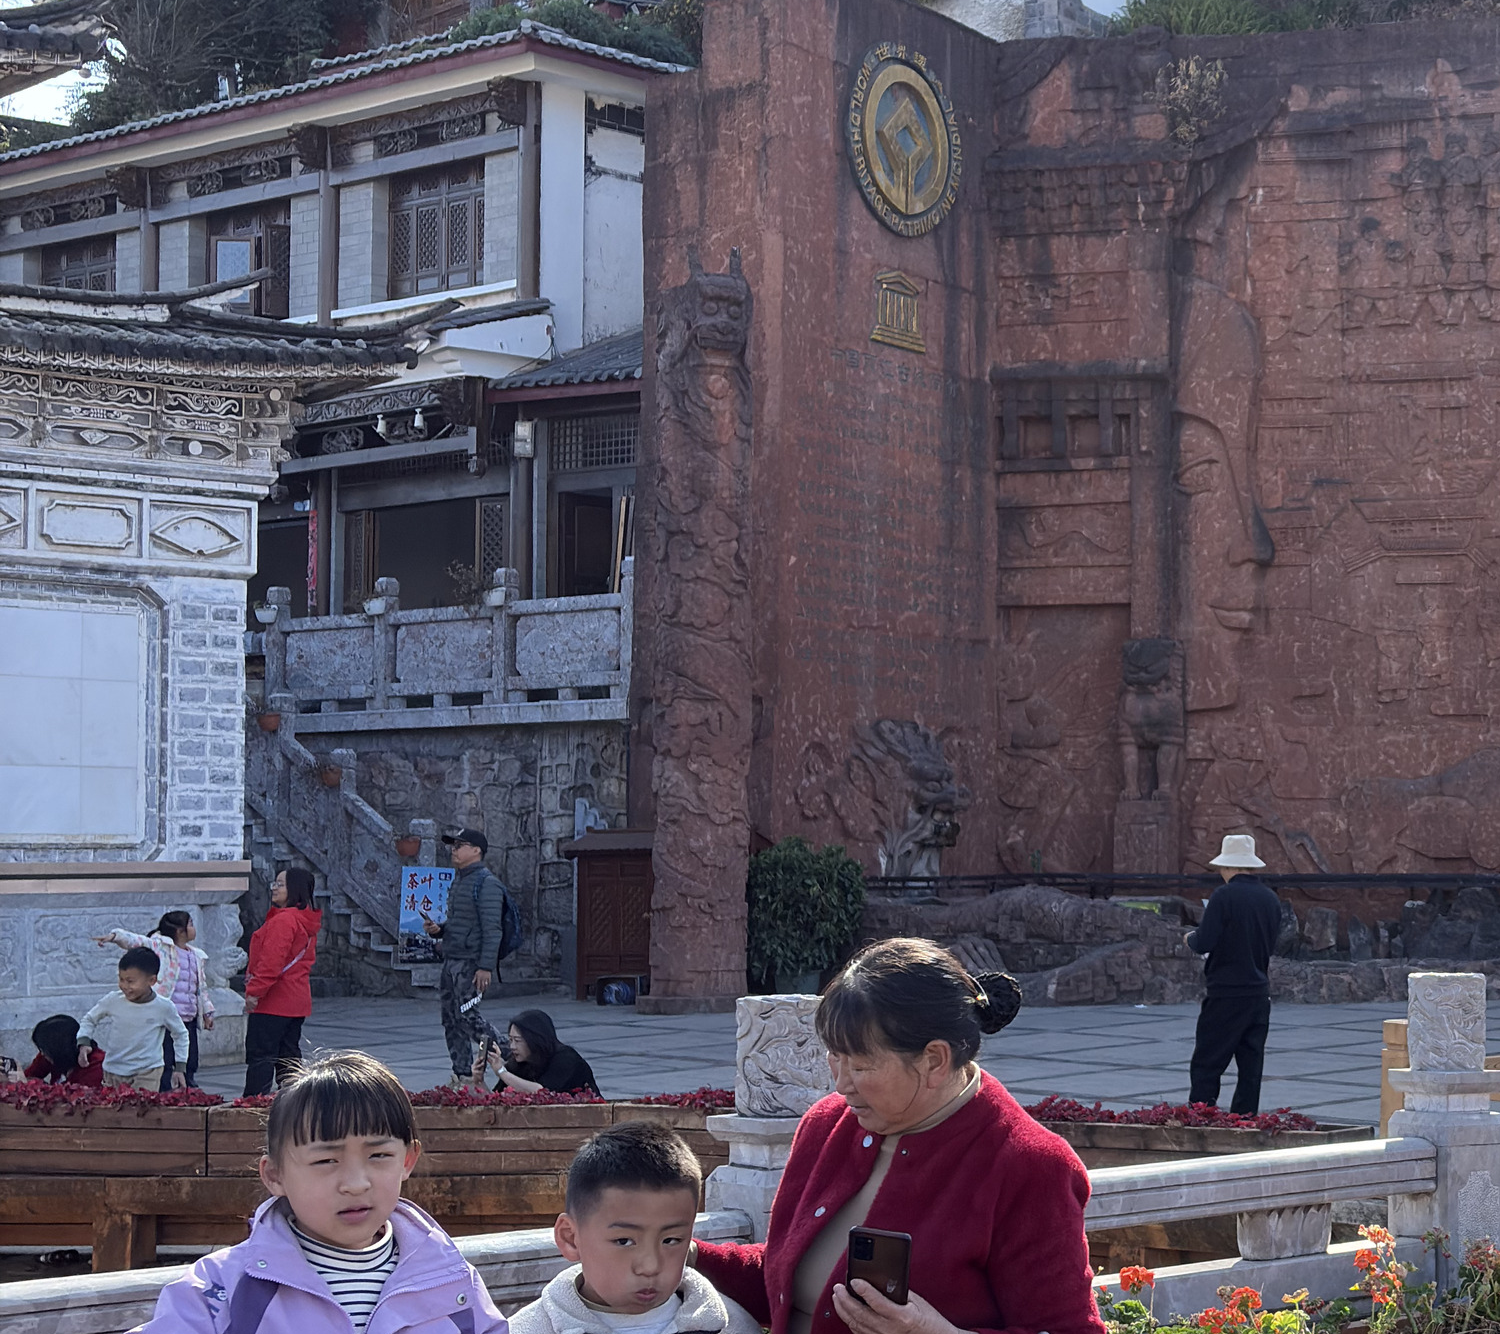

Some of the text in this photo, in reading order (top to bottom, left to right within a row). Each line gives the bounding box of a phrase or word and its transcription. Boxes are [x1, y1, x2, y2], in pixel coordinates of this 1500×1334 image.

[851, 62, 891, 219] WORLD HERITAGE
[891, 100, 963, 237] PATRIMOINE MONDIAL
[404, 893, 433, 911] 清仓
[407, 872, 434, 890] 茶叶
